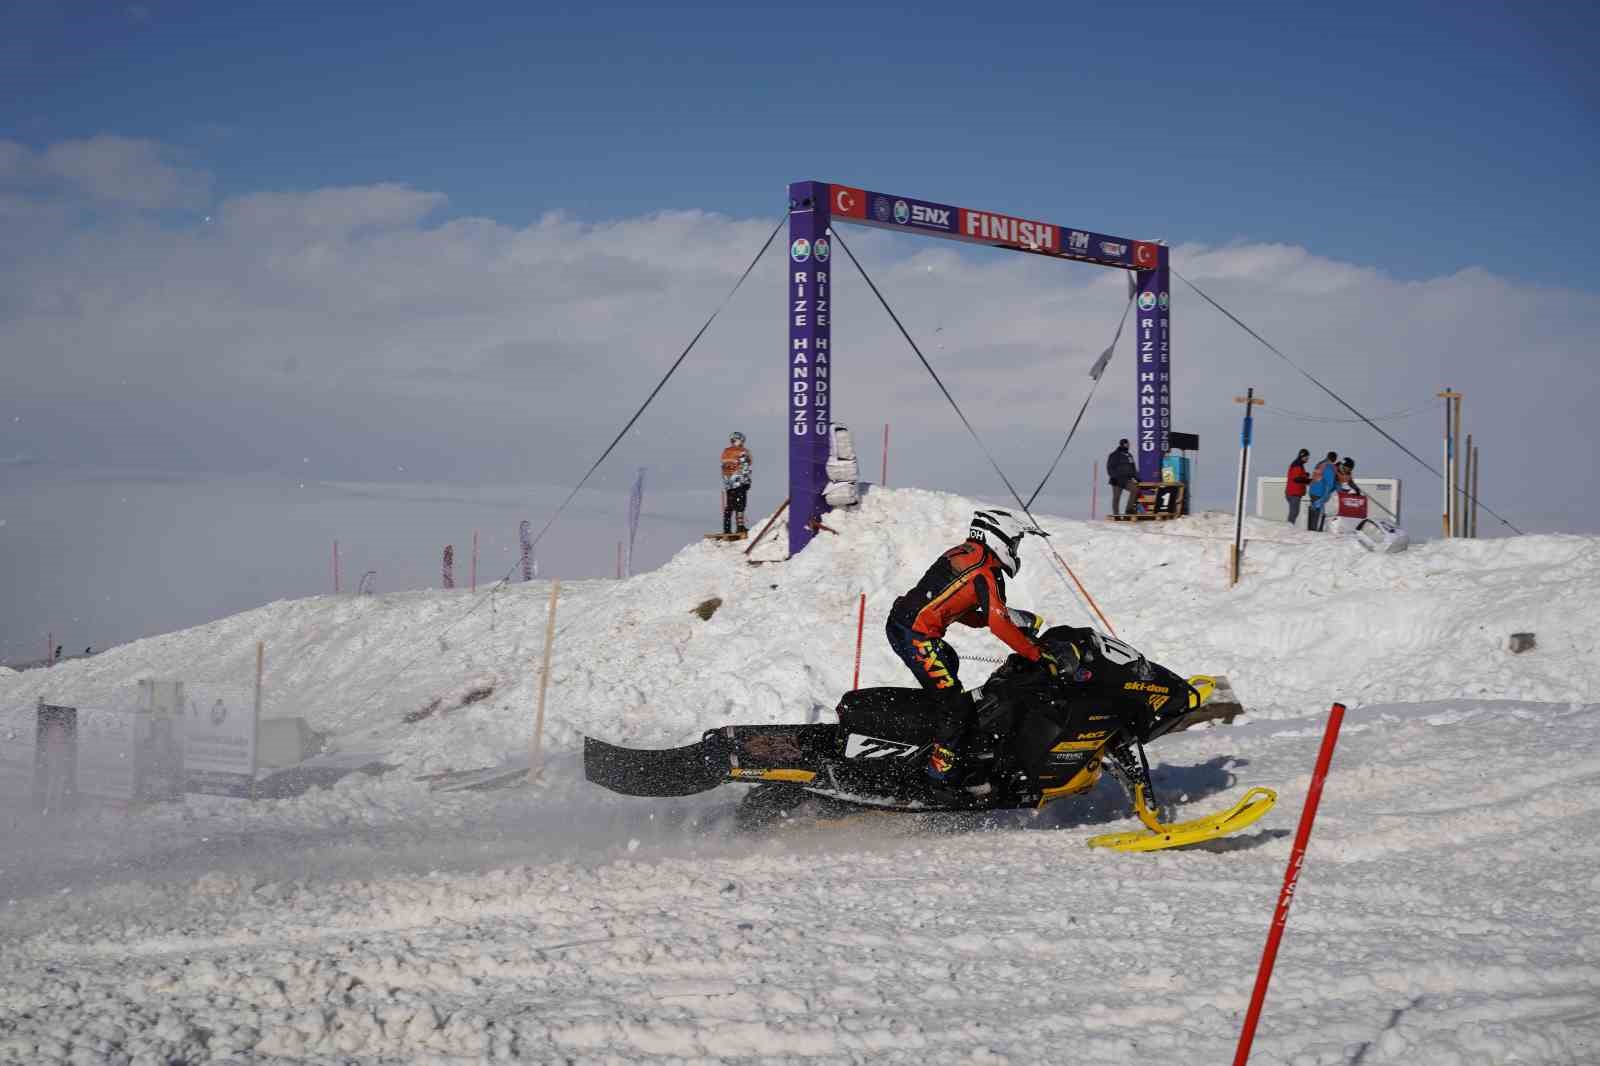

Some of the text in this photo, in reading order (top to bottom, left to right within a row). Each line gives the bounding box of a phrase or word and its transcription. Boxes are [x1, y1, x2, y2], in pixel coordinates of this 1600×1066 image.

[911, 204, 951, 225] SNX
[966, 211, 1054, 249] FINISH
[792, 337, 809, 436] HANDÜZÜ
[814, 336, 829, 436] HANDÜZÜ
[1160, 492, 1171, 506] 1
